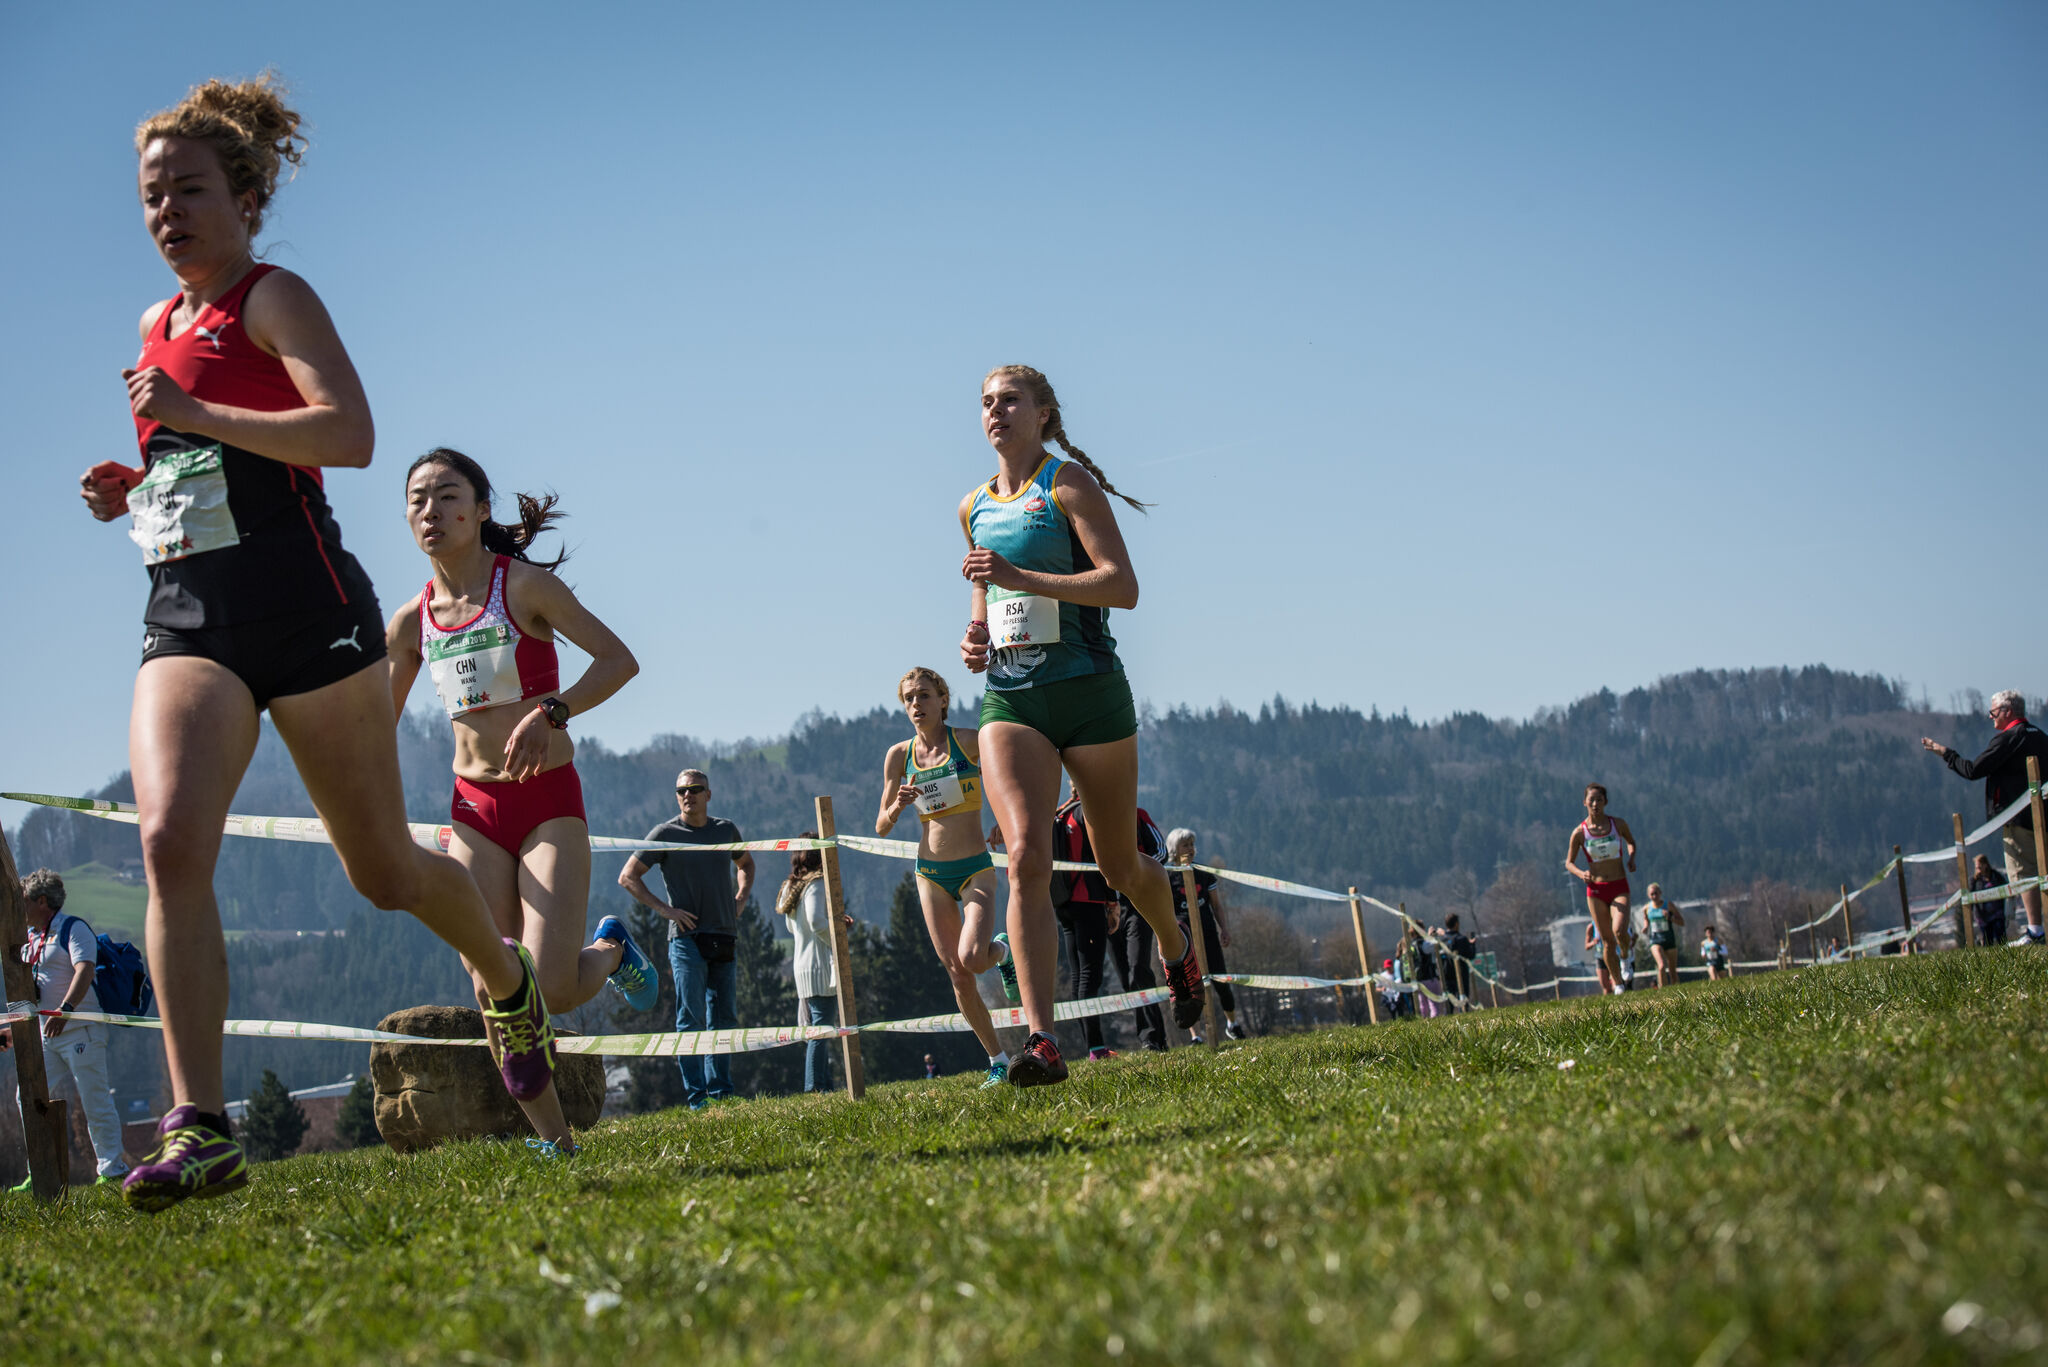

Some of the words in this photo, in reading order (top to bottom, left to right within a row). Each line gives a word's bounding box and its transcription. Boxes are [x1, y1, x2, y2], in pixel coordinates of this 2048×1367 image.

[1006, 601, 1024, 616] RSA
[470, 633, 487, 645] 2018
[456, 657, 477, 674] CHN
[461, 676, 477, 685] WANG
[924, 783, 938, 794] AUS
